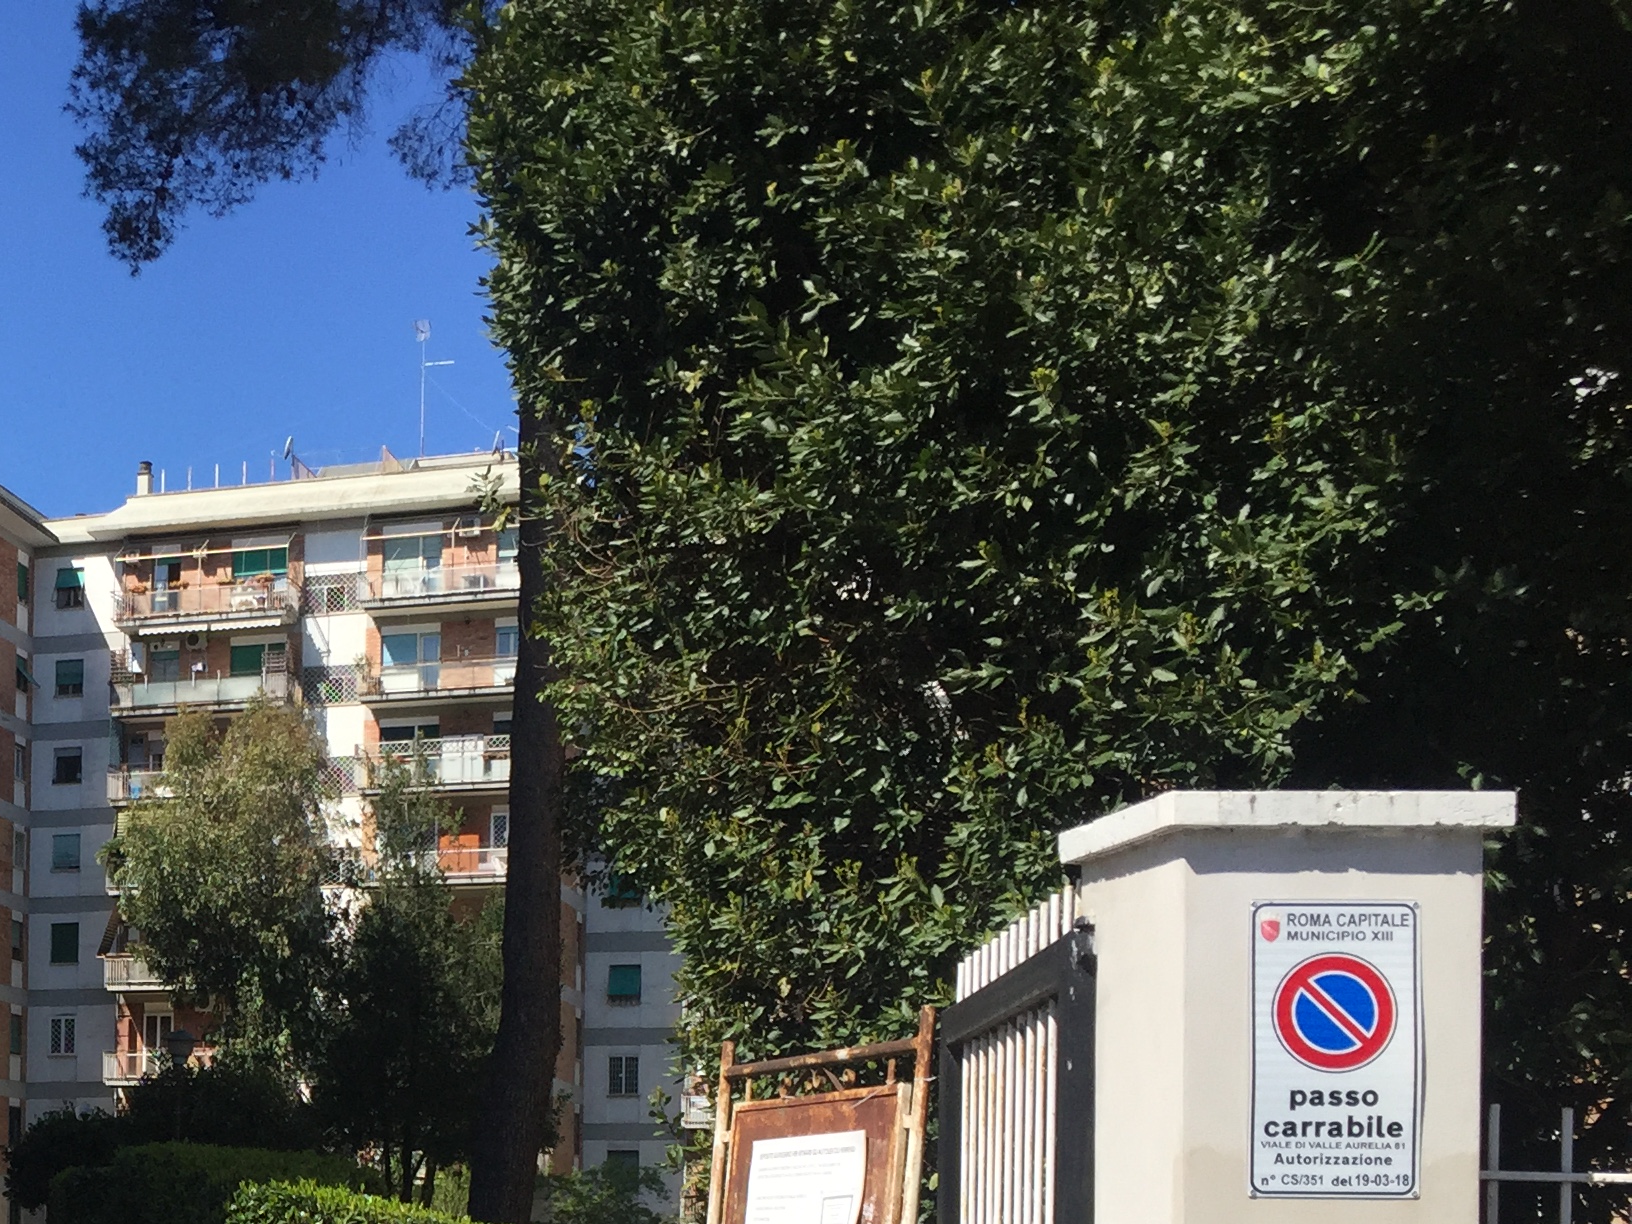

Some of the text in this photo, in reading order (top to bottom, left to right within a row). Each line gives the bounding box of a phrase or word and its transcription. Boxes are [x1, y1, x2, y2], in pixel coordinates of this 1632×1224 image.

[1287, 913, 1410, 928] ROMA CAPITALE
[1287, 931, 1394, 942] MUNICIPIO XIII
[1290, 1089, 1379, 1111] passo
[1264, 1115, 1404, 1138] carrabile
[1260, 1141, 1292, 1149] VIALE
[1308, 1142, 1342, 1150] VALLE
[1345, 1142, 1392, 1150] AURELIA
[1274, 1153, 1393, 1166] Autorizzazione
[1281, 1174, 1324, 1186] CS/351
[1331, 1176, 1352, 1186] del
[1356, 1174, 1410, 1186] 19-03-18
